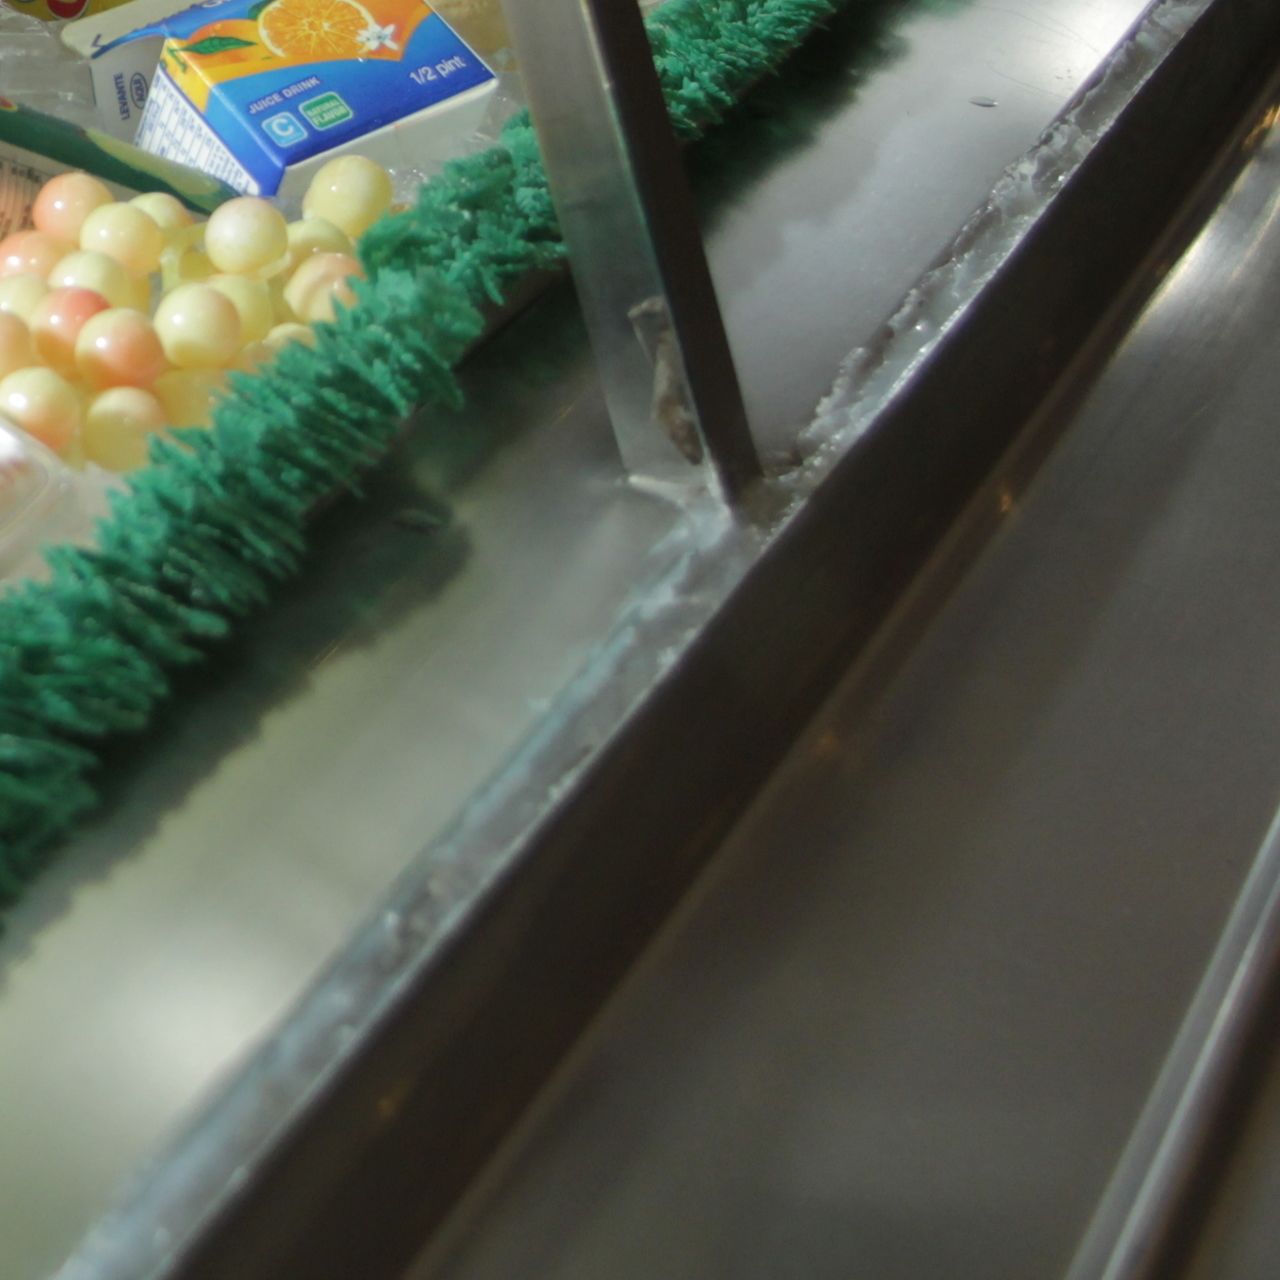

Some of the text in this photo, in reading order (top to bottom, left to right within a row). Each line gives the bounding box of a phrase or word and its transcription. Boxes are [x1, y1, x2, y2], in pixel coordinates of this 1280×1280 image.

[409, 55, 465, 86] 1/2 pint
[248, 76, 321, 115] JUICE DRINK
